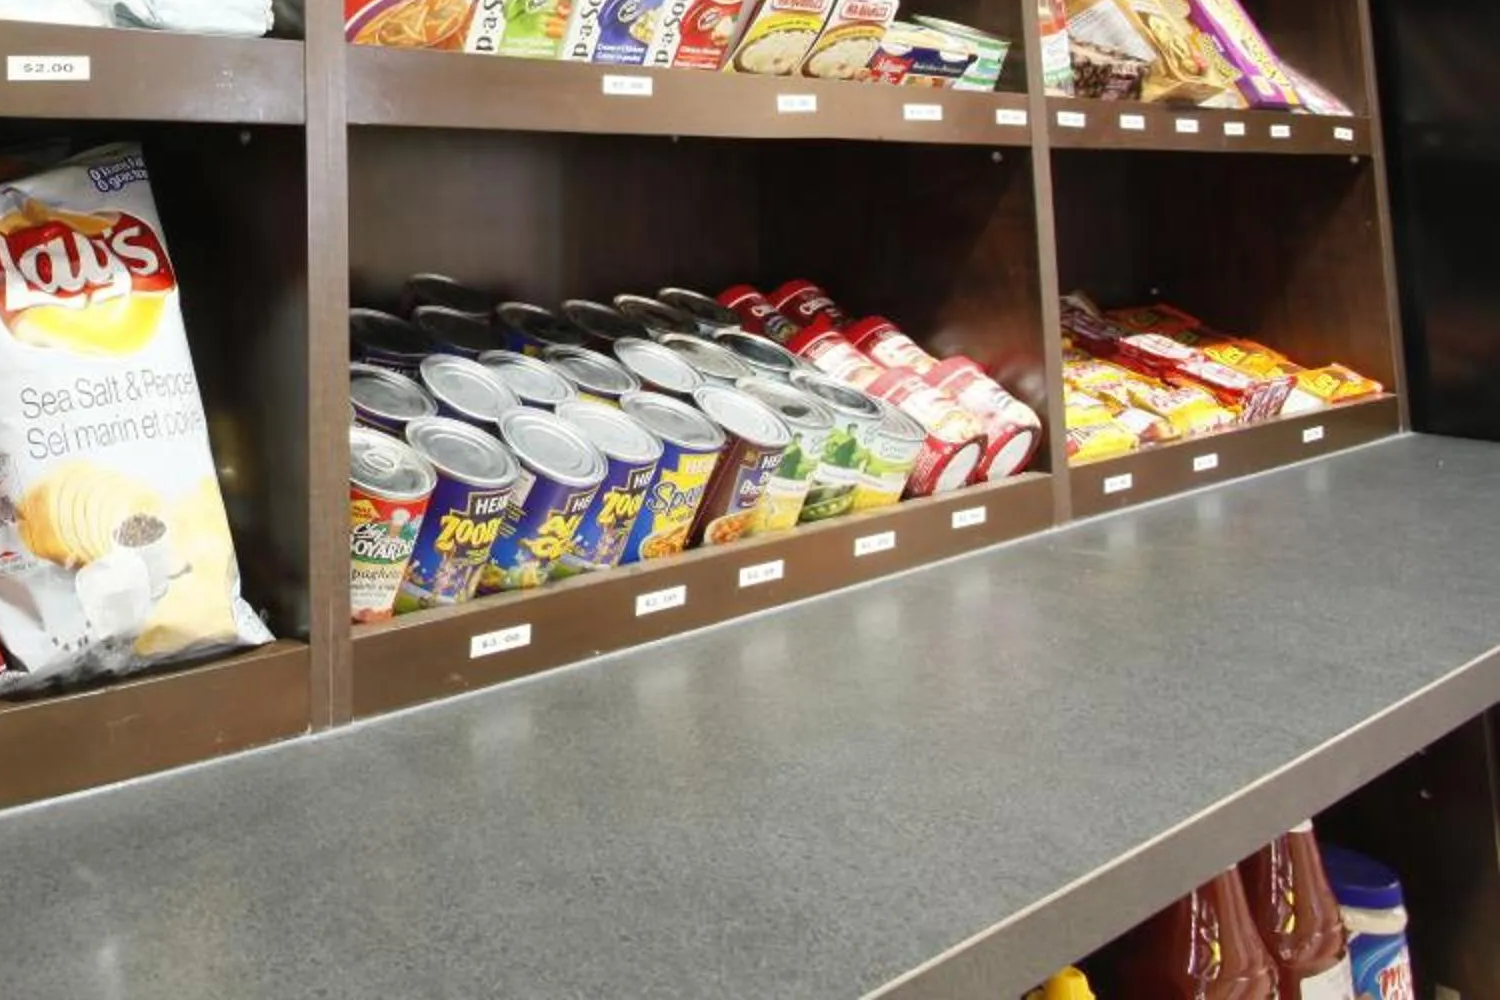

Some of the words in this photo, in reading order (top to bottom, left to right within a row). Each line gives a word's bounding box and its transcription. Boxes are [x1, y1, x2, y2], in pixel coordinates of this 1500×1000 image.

[22, 61, 76, 75] $2.00
[20, 387, 74, 419] Sea
[75, 376, 121, 409] Salt
[126, 371, 143, 401] &
[27, 424, 69, 460] Sel
[75, 415, 139, 449] marin
[142, 411, 159, 440] et
